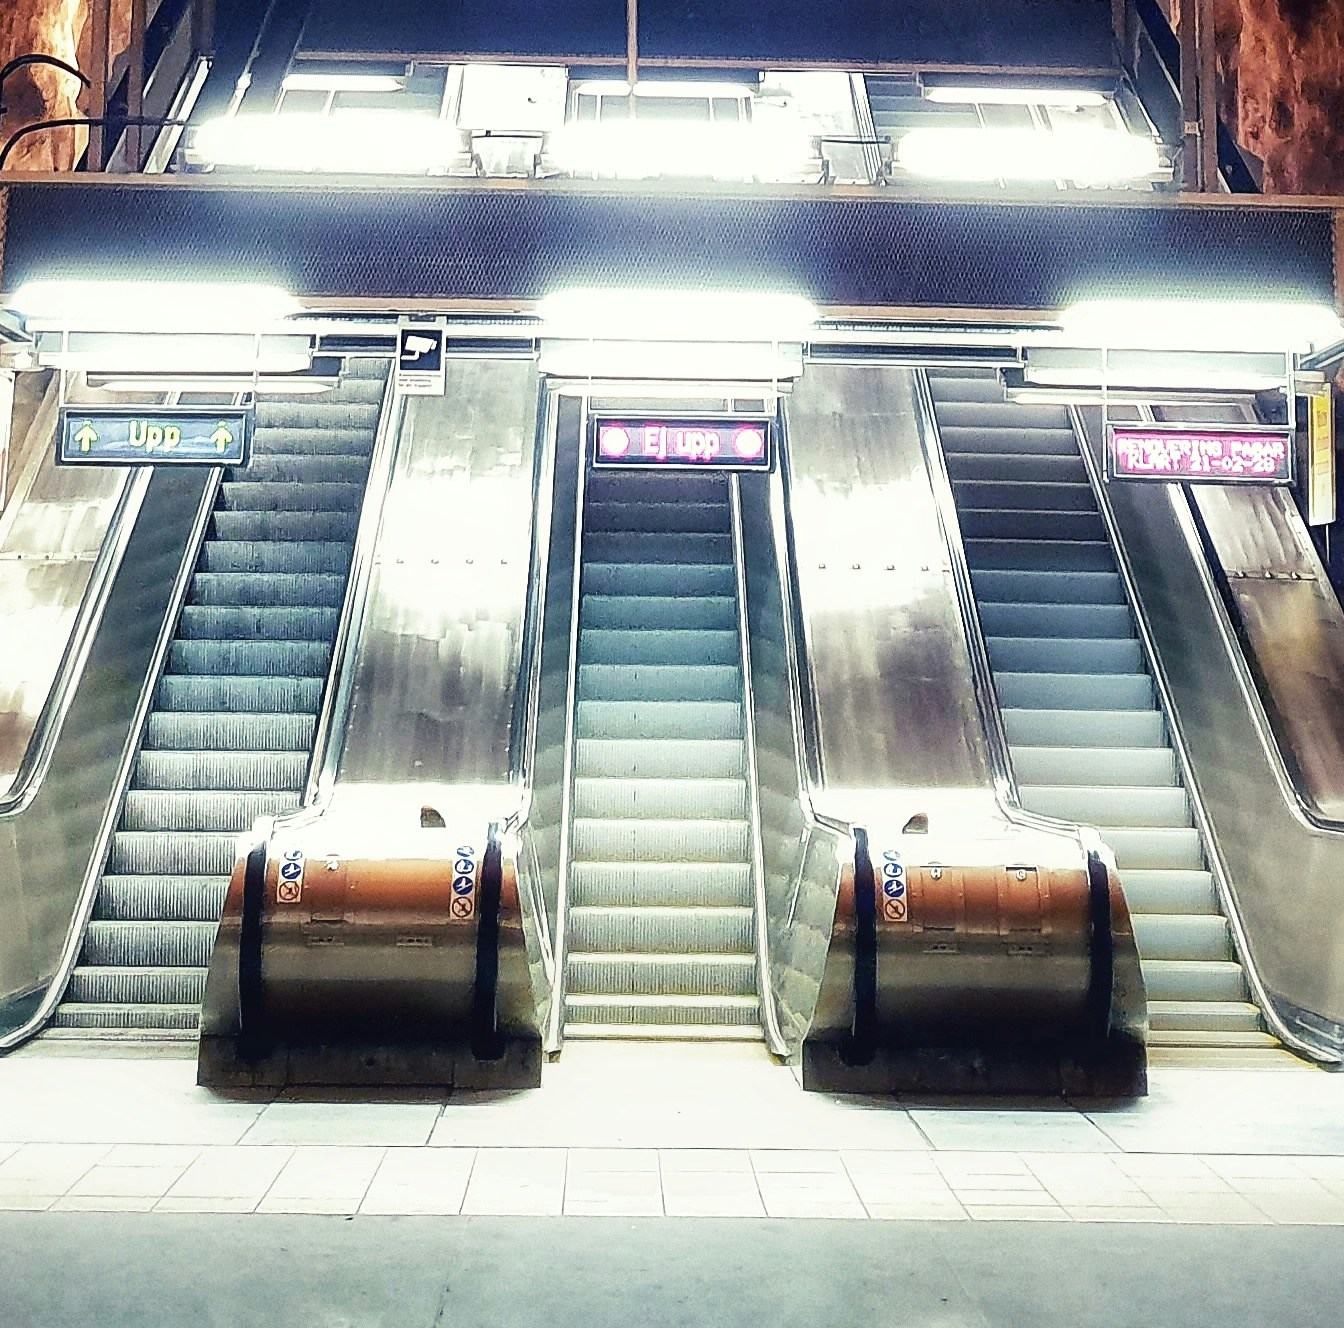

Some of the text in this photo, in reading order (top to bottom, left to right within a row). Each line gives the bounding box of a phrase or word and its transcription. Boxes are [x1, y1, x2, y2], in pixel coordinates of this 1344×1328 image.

[128, 420, 182, 454] Upp
[644, 426, 721, 462] Ej upp
[1188, 455, 1276, 473] 21-02-28
